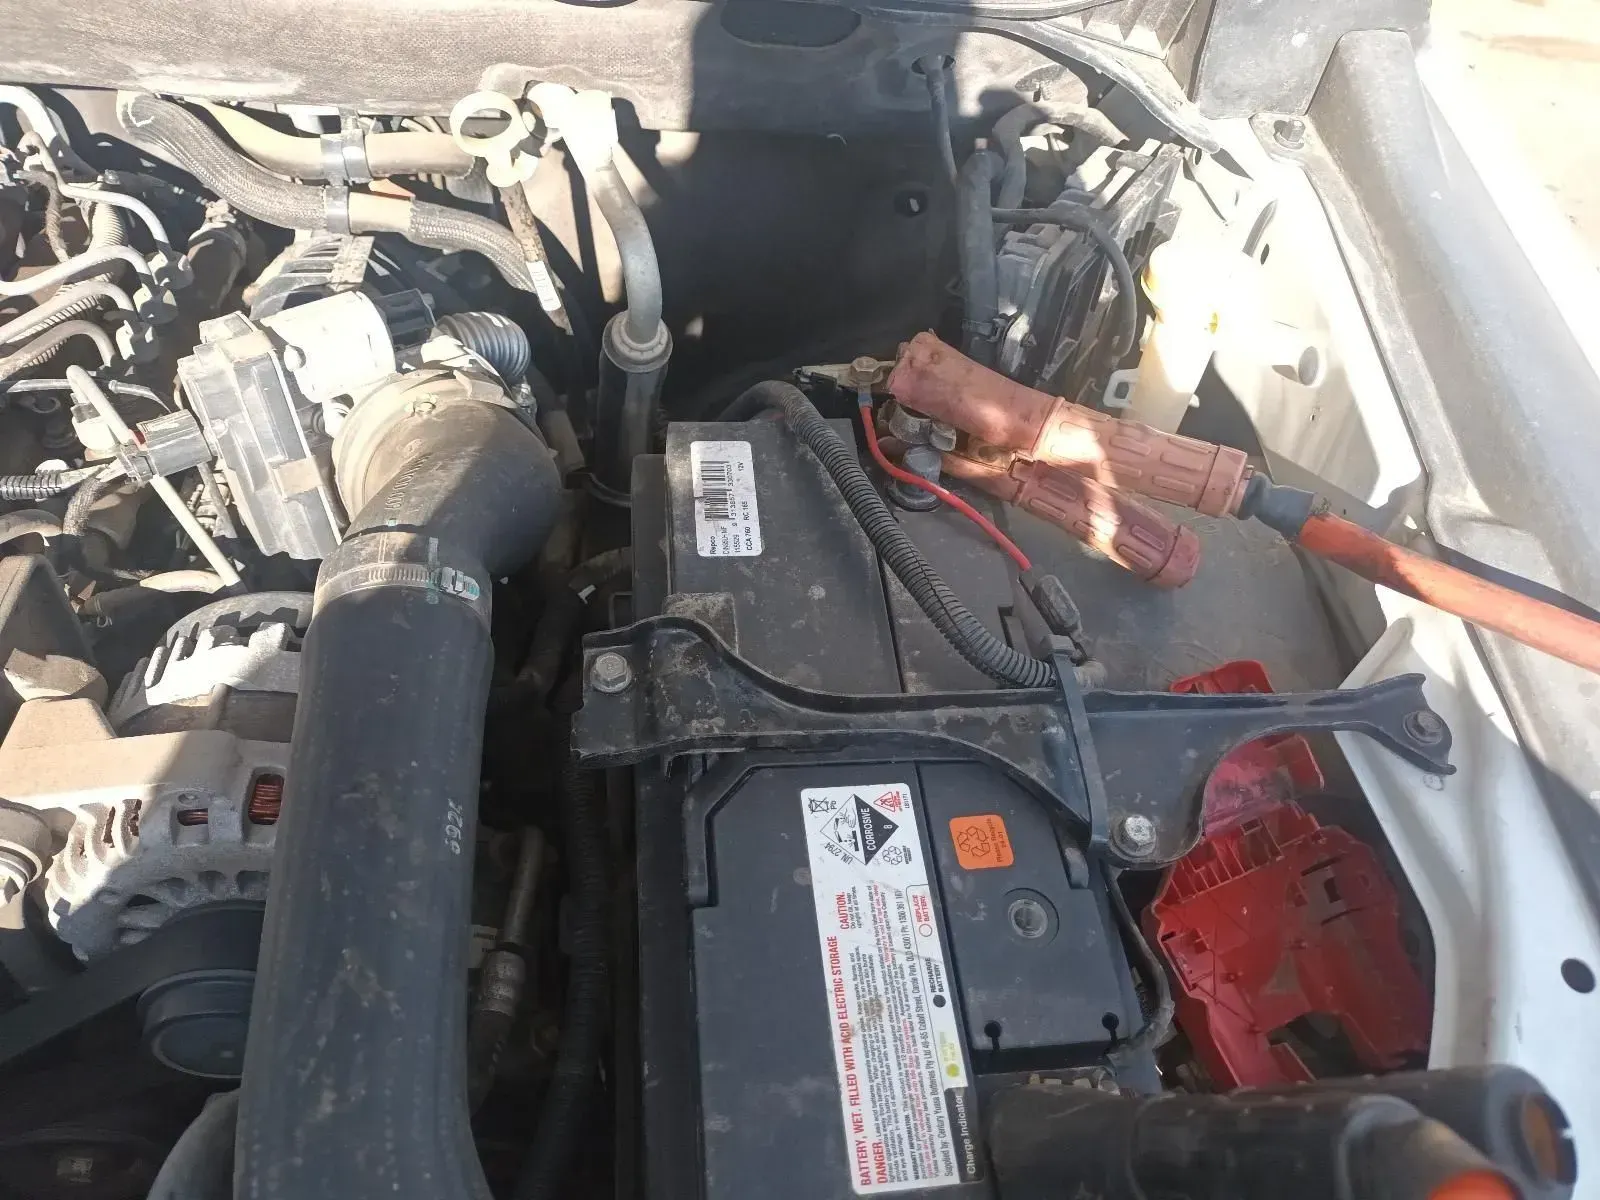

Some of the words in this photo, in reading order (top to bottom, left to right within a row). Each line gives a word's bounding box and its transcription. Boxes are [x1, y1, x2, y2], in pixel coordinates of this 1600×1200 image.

[742, 512, 750, 520] RC
[830, 800, 837, 810] Pb
[861, 808, 876, 851] CORROSIVE
[824, 842, 842, 857] 2794
[836, 892, 850, 929] CAUTION.
[912, 895, 923, 922] REPLACE
[920, 895, 930, 922] BATTERY
[827, 936, 842, 976] STORAGE
[925, 958, 937, 993] RECHARGE
[934, 963, 944, 992] BATTERY
[833, 978, 848, 1020] ELECTRIC
[839, 1022, 851, 1044] ACID
[842, 1046, 855, 1071] WITH
[846, 1074, 860, 1106] FILLED
[851, 1109, 864, 1134] WET.
[933, 1115, 947, 1139] Century
[954, 1095, 969, 1136] Indicator
[855, 1136, 872, 1186] BATTERY,
[872, 1139, 888, 1184] DANGER.
[940, 1150, 954, 1177] Supplied
[962, 1138, 977, 1175] Charge
